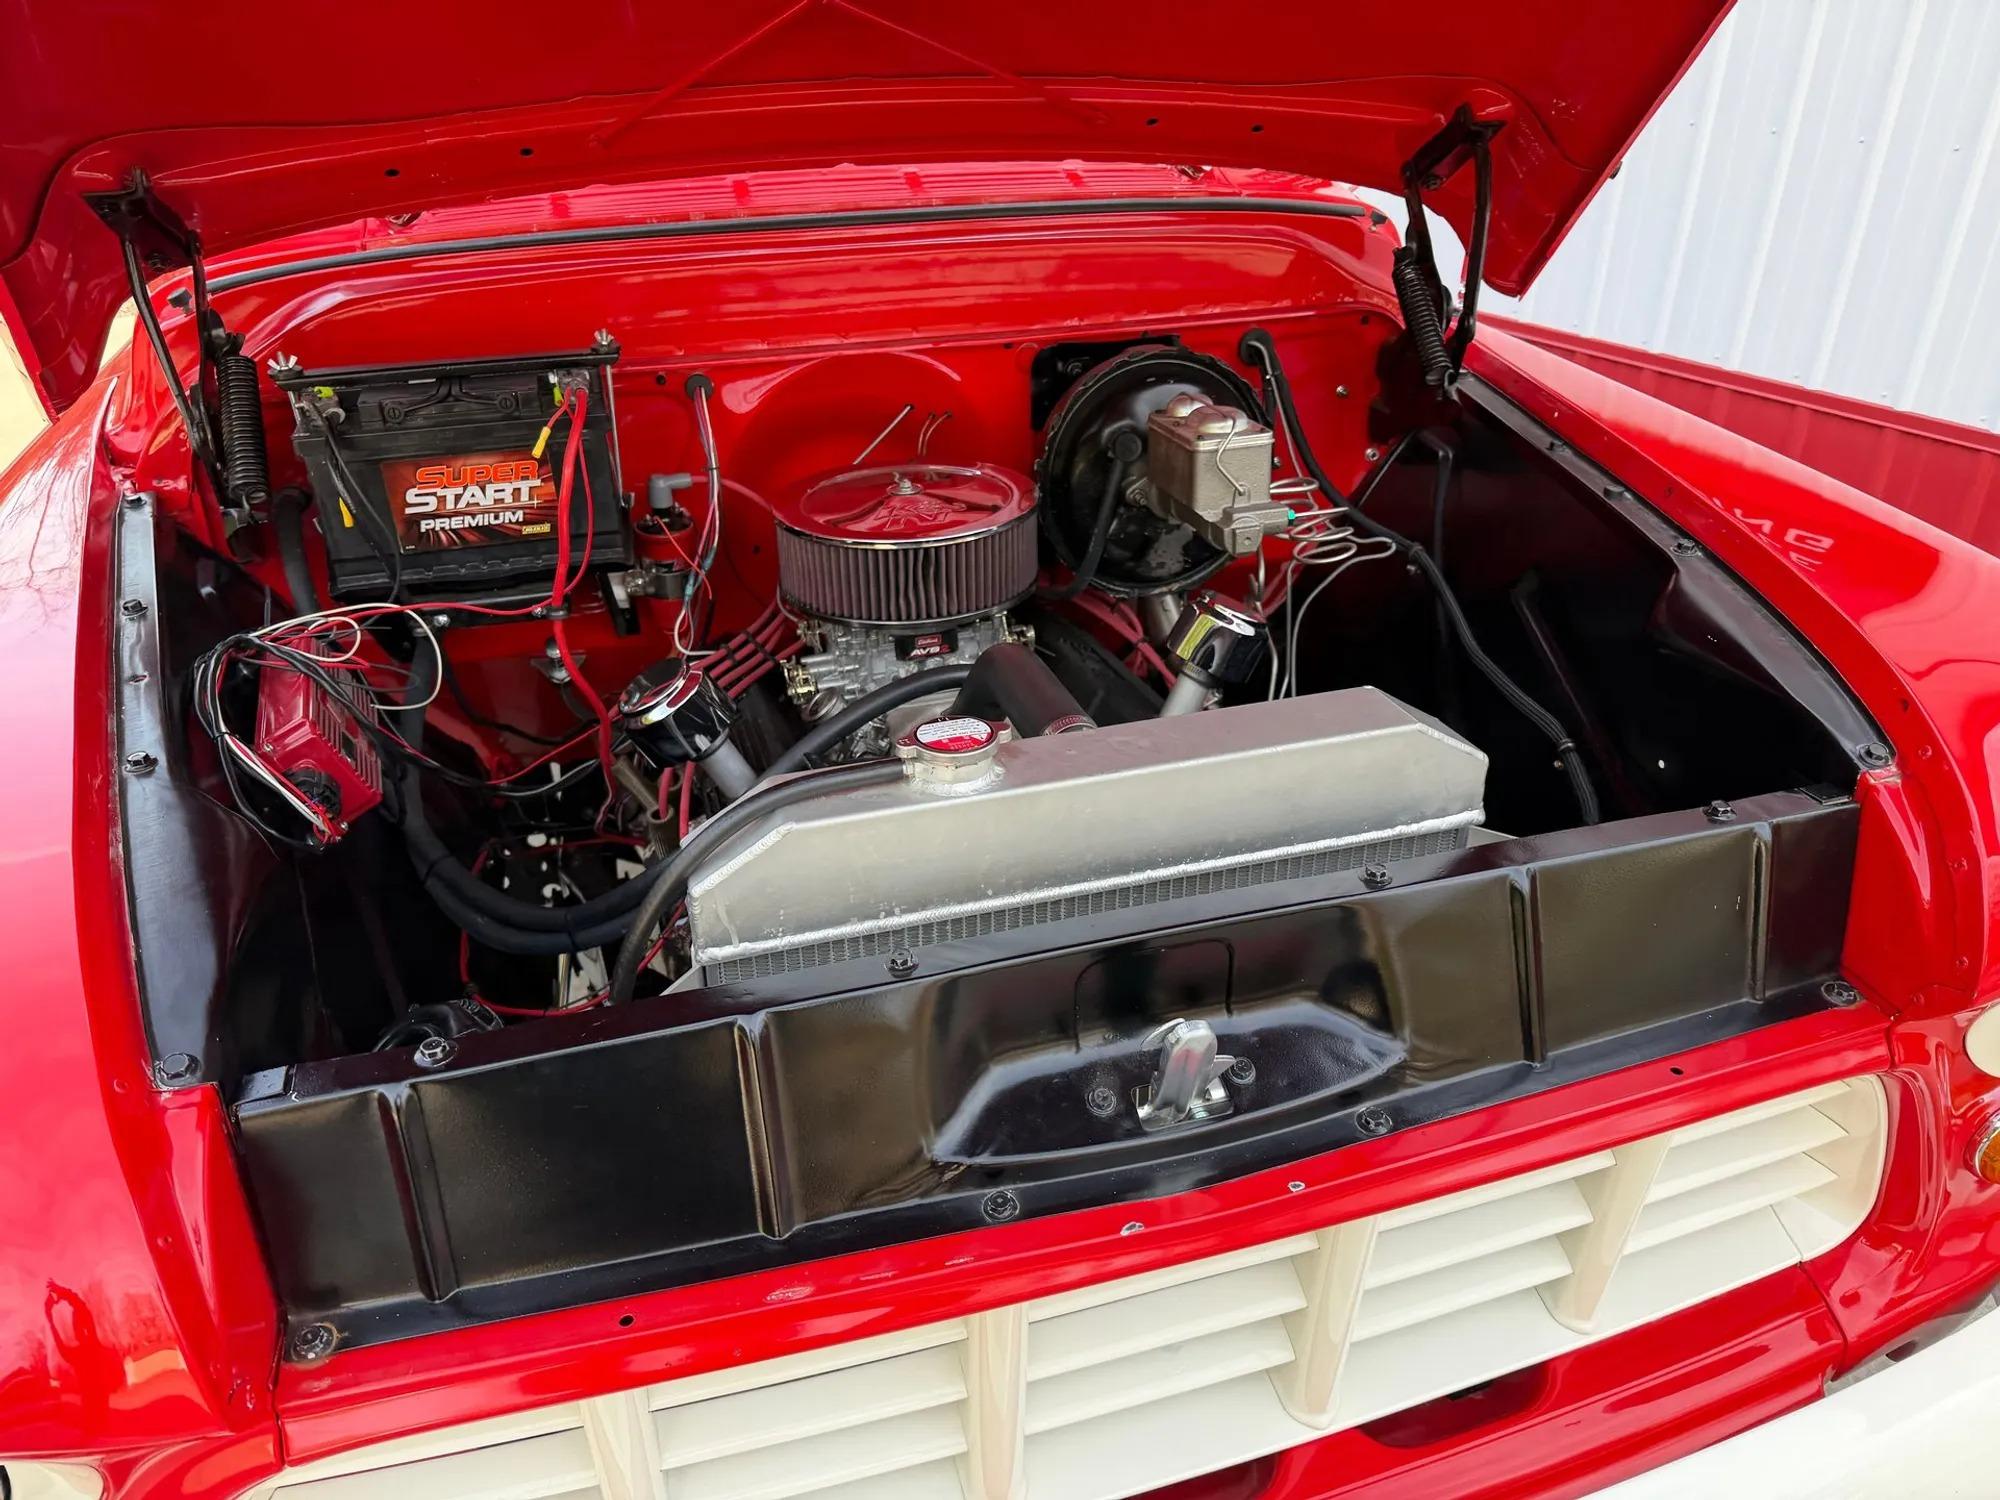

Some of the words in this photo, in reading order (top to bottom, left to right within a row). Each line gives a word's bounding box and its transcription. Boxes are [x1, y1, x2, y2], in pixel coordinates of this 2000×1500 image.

[417, 461, 538, 490] SUPER
[405, 479, 541, 514] START
[420, 510, 524, 533] PREMIUM
